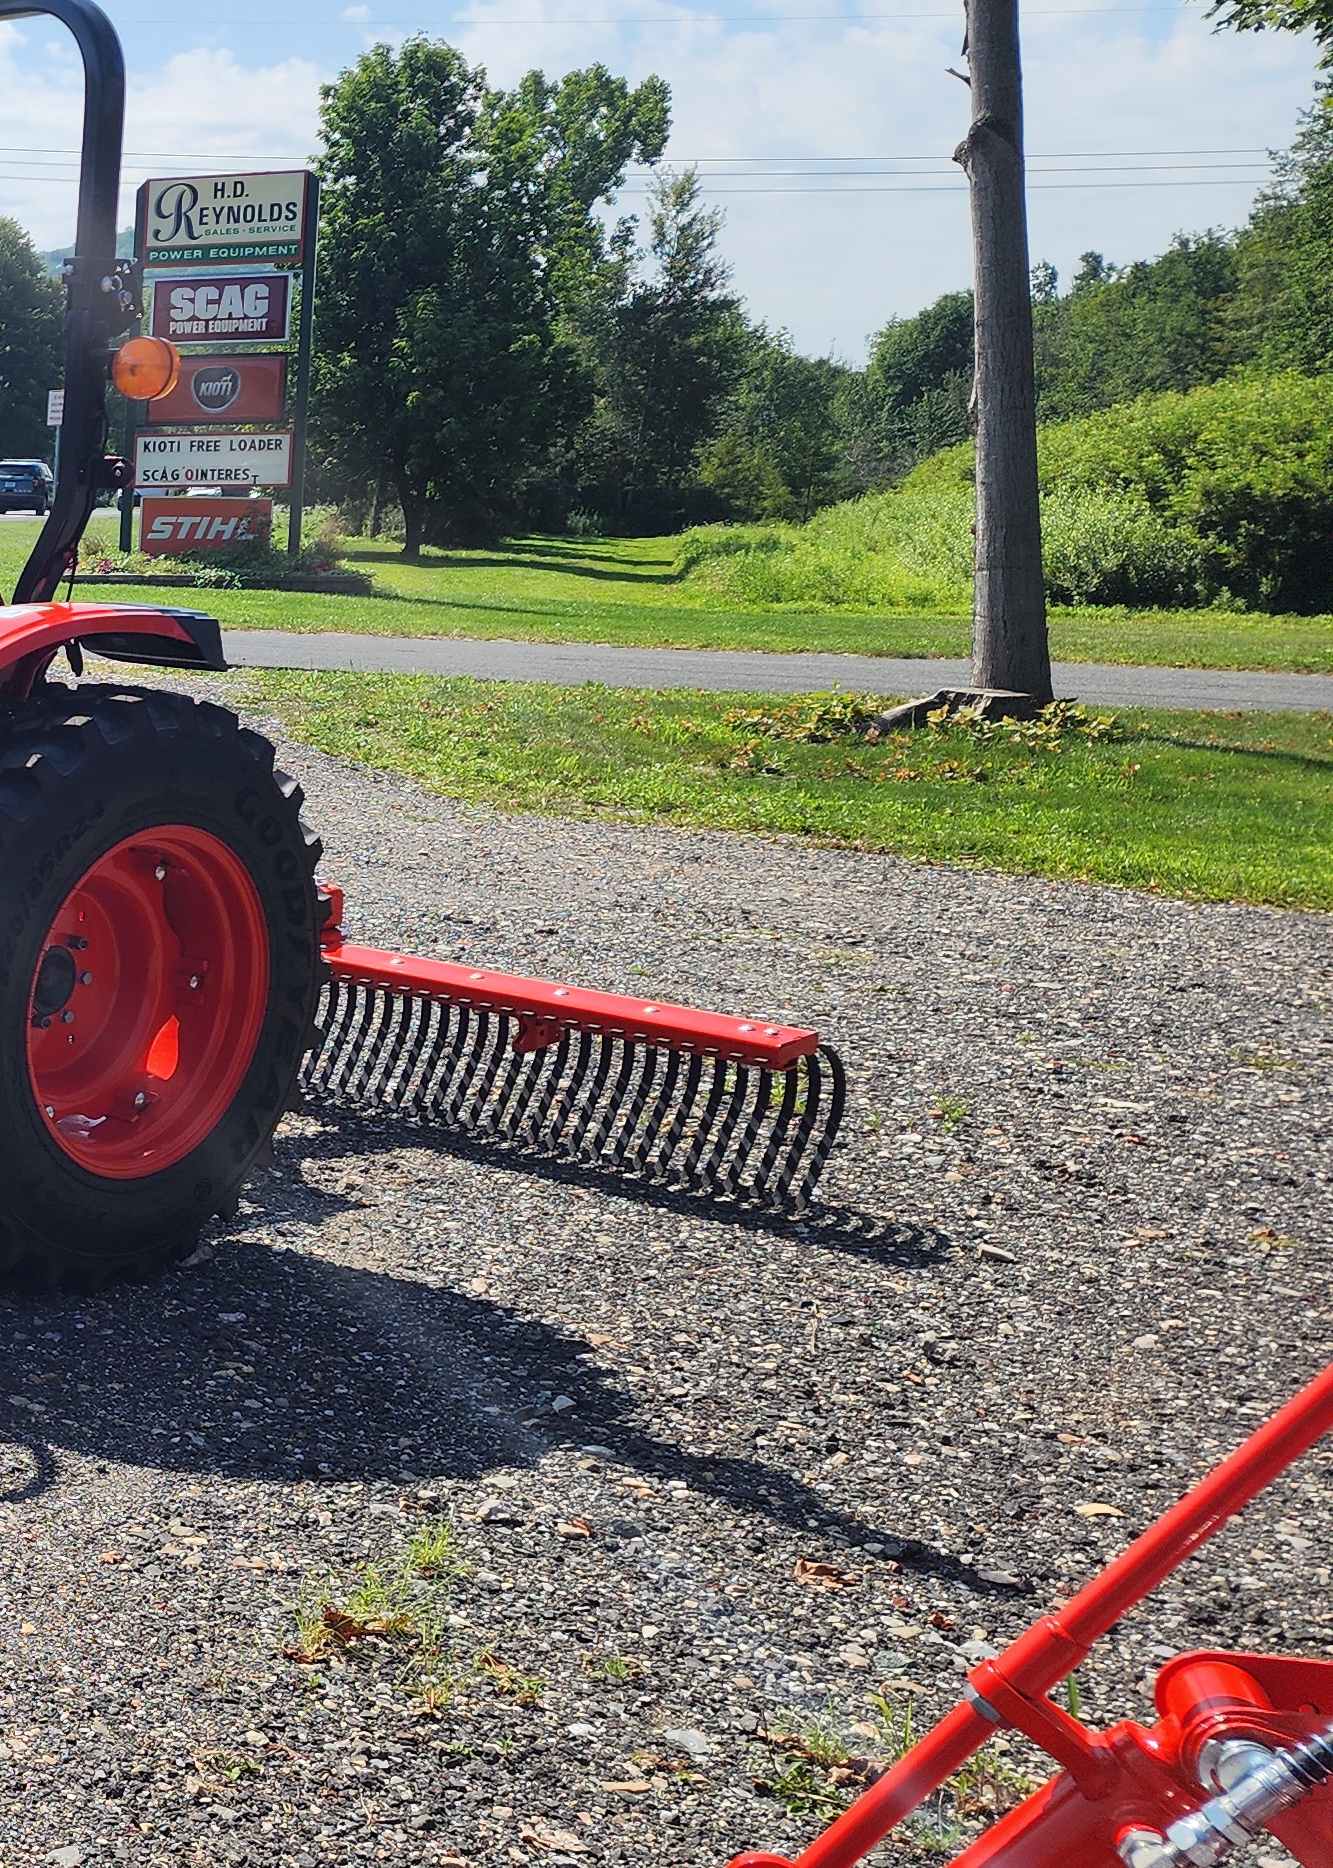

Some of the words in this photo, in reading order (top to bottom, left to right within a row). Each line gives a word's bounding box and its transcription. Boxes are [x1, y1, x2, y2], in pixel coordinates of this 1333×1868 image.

[213, 180, 250, 200] H.D.
[152, 182, 298, 243] REYNOLDS
[204, 227, 240, 236] SALES
[248, 224, 297, 234] SERVICE
[149, 249, 203, 261] POWER
[209, 244, 298, 258] EQUIPMENT
[169, 283, 270, 321] SCAG
[169, 321, 206, 335] POWER
[208, 318, 269, 333] EQUIPMENT
[198, 381, 233, 397] KIOTI
[143, 440, 181, 453] KIOTI
[189, 439, 221, 452] FREE
[229, 438, 283, 451] LOADER
[142, 468, 180, 482] SCAG
